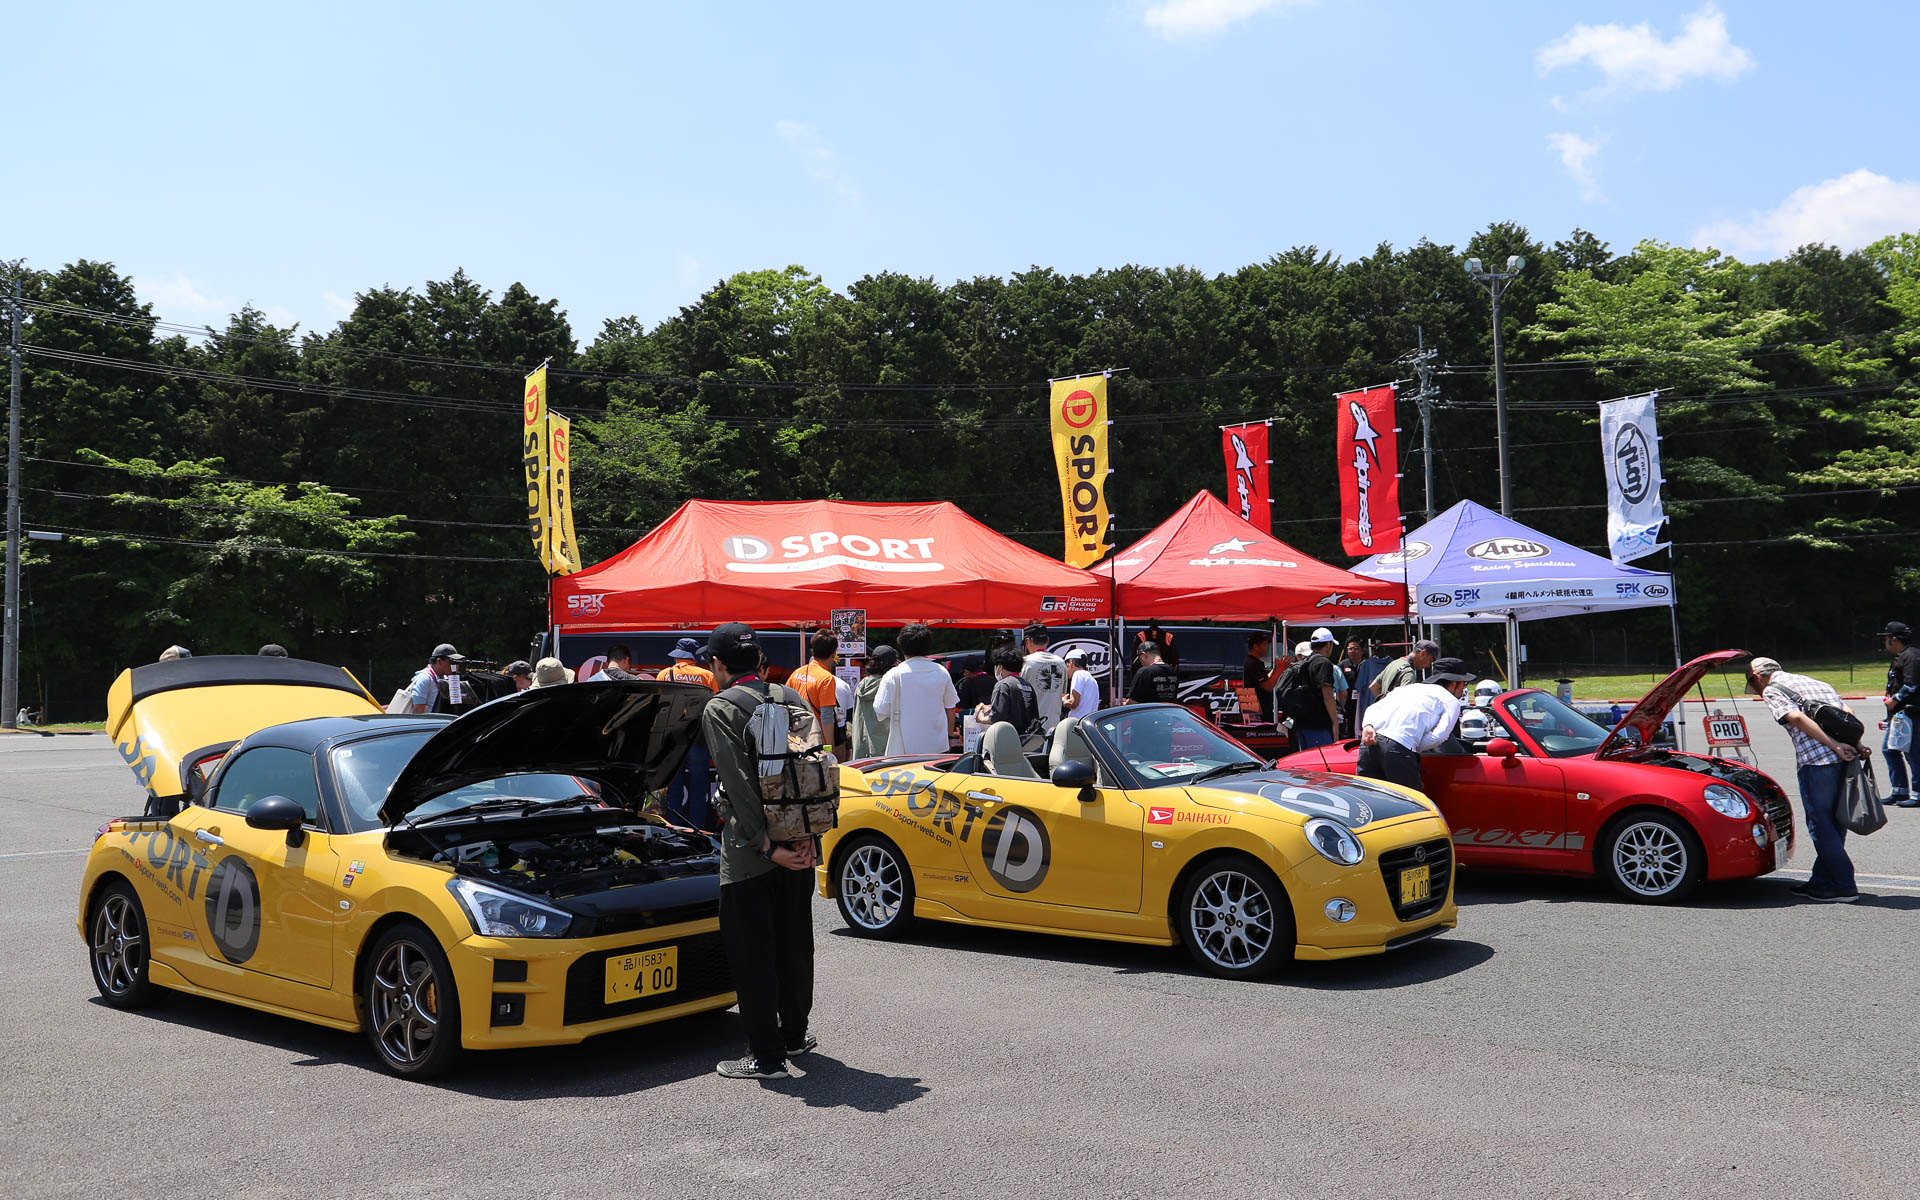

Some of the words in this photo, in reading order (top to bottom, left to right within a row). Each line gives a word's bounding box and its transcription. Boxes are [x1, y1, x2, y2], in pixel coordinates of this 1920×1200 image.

[1617, 426, 1643, 495] Arai
[781, 531, 935, 560] SPORT
[1477, 541, 1540, 557] Arai
[1470, 563, 1513, 572] Racing
[1616, 582, 1641, 594] SPK
[1646, 586, 1667, 596] Arai
[567, 594, 606, 608] SPK
[1339, 599, 1396, 608] alpinestars
[1426, 593, 1450, 605] Arai
[1454, 588, 1481, 600] SPK
[1042, 601, 1067, 611] GR
[1713, 722, 1740, 737] PRO
[871, 769, 984, 843] SPORT
[1176, 811, 1232, 825] DAIHATSU
[121, 823, 209, 900] ORT
[954, 874, 969, 883] SPK
